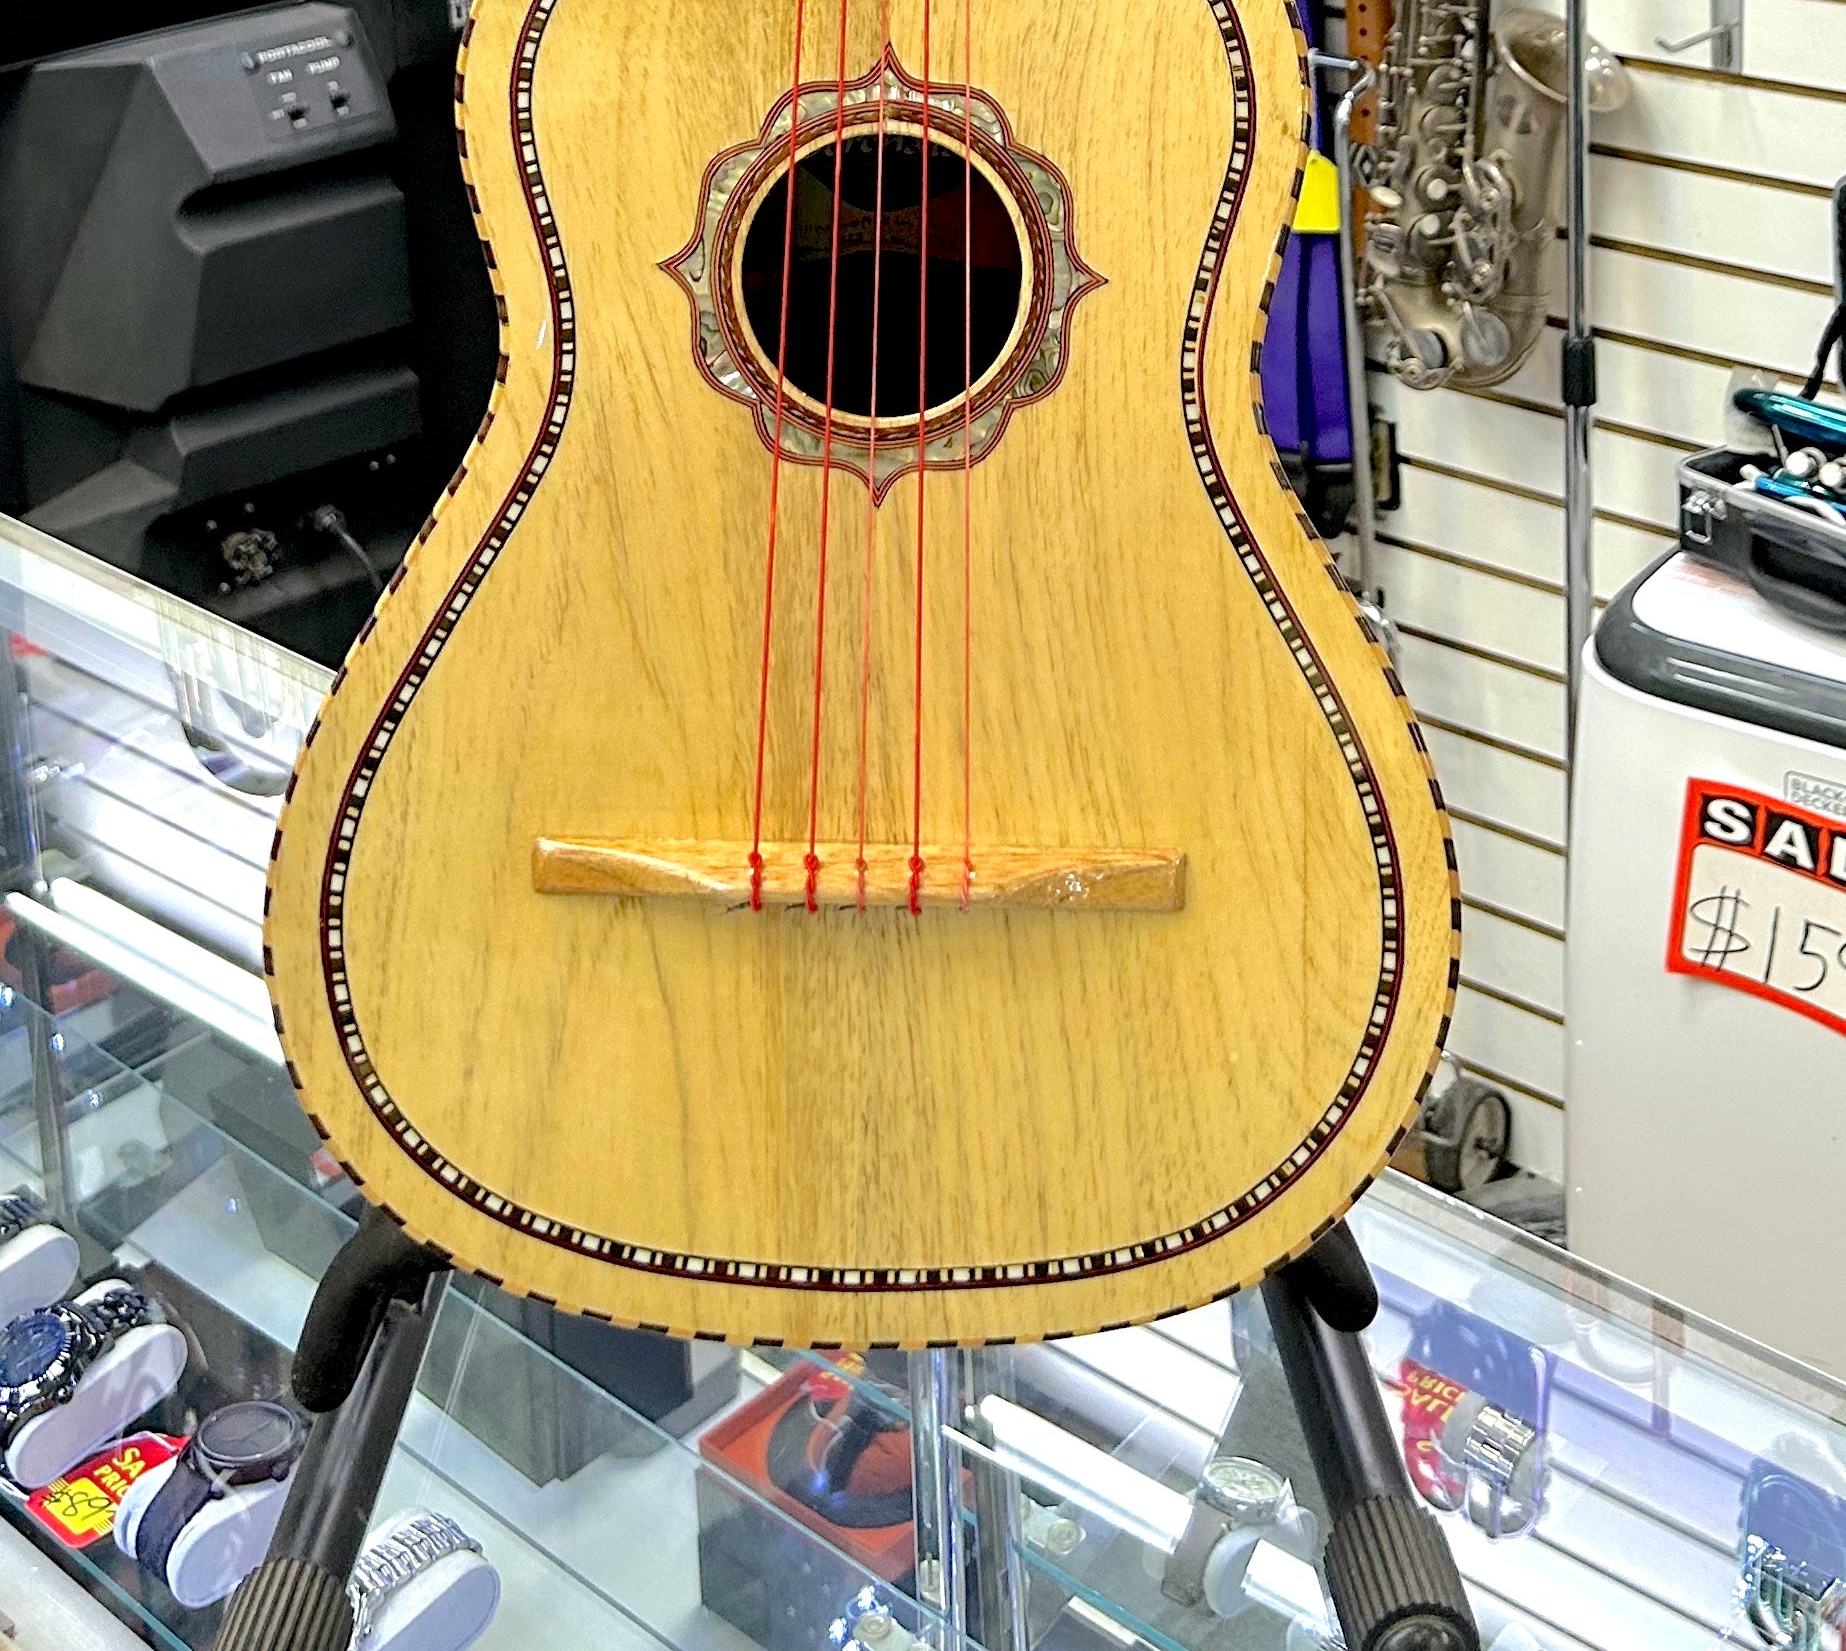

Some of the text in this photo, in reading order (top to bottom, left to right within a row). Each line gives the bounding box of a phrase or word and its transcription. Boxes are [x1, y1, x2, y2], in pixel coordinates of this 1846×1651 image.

[1791, 791, 1846, 816] DECKE
[1690, 885, 1846, 992] $15
[111, 1447, 146, 1479] SA
[93, 1464, 130, 1498] PRIC
